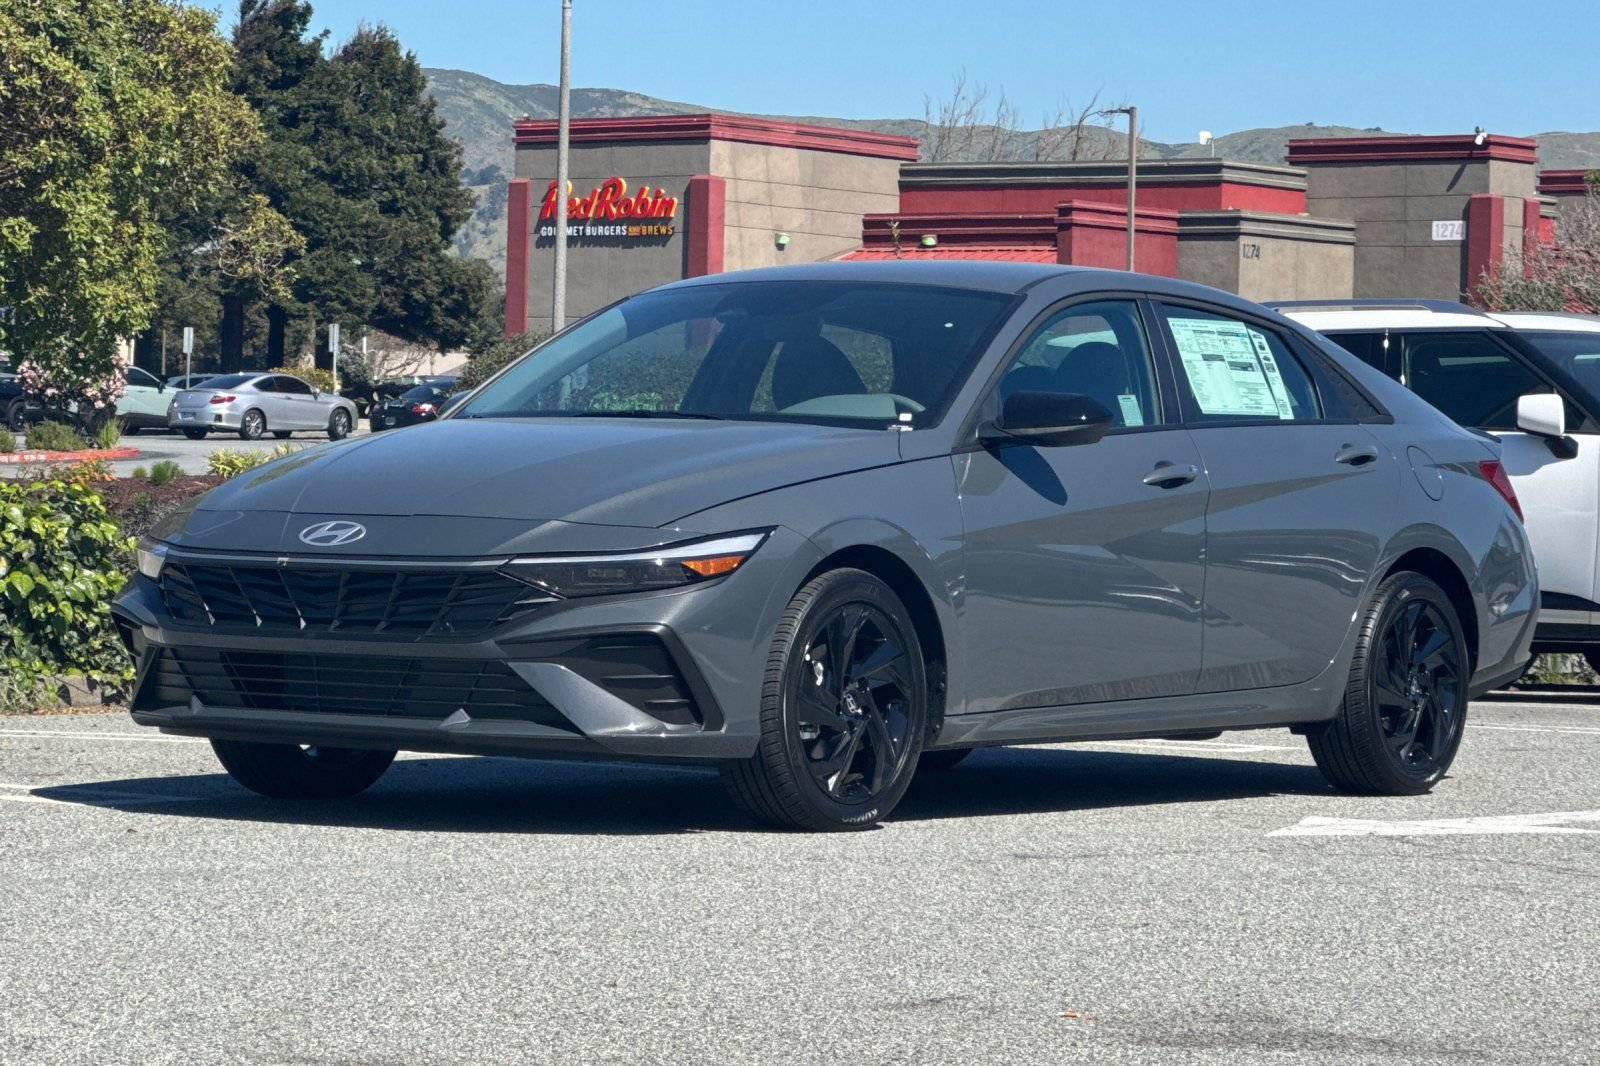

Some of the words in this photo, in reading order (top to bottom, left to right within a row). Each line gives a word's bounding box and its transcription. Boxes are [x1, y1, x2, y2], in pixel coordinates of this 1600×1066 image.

[540, 179, 601, 219] Red
[594, 177, 678, 221] Robin
[541, 226, 584, 237] GOMET
[585, 225, 627, 236] BURGERS
[641, 225, 673, 236] BREWS
[1435, 222, 1464, 239] 1274
[1243, 244, 1260, 260] 1274
